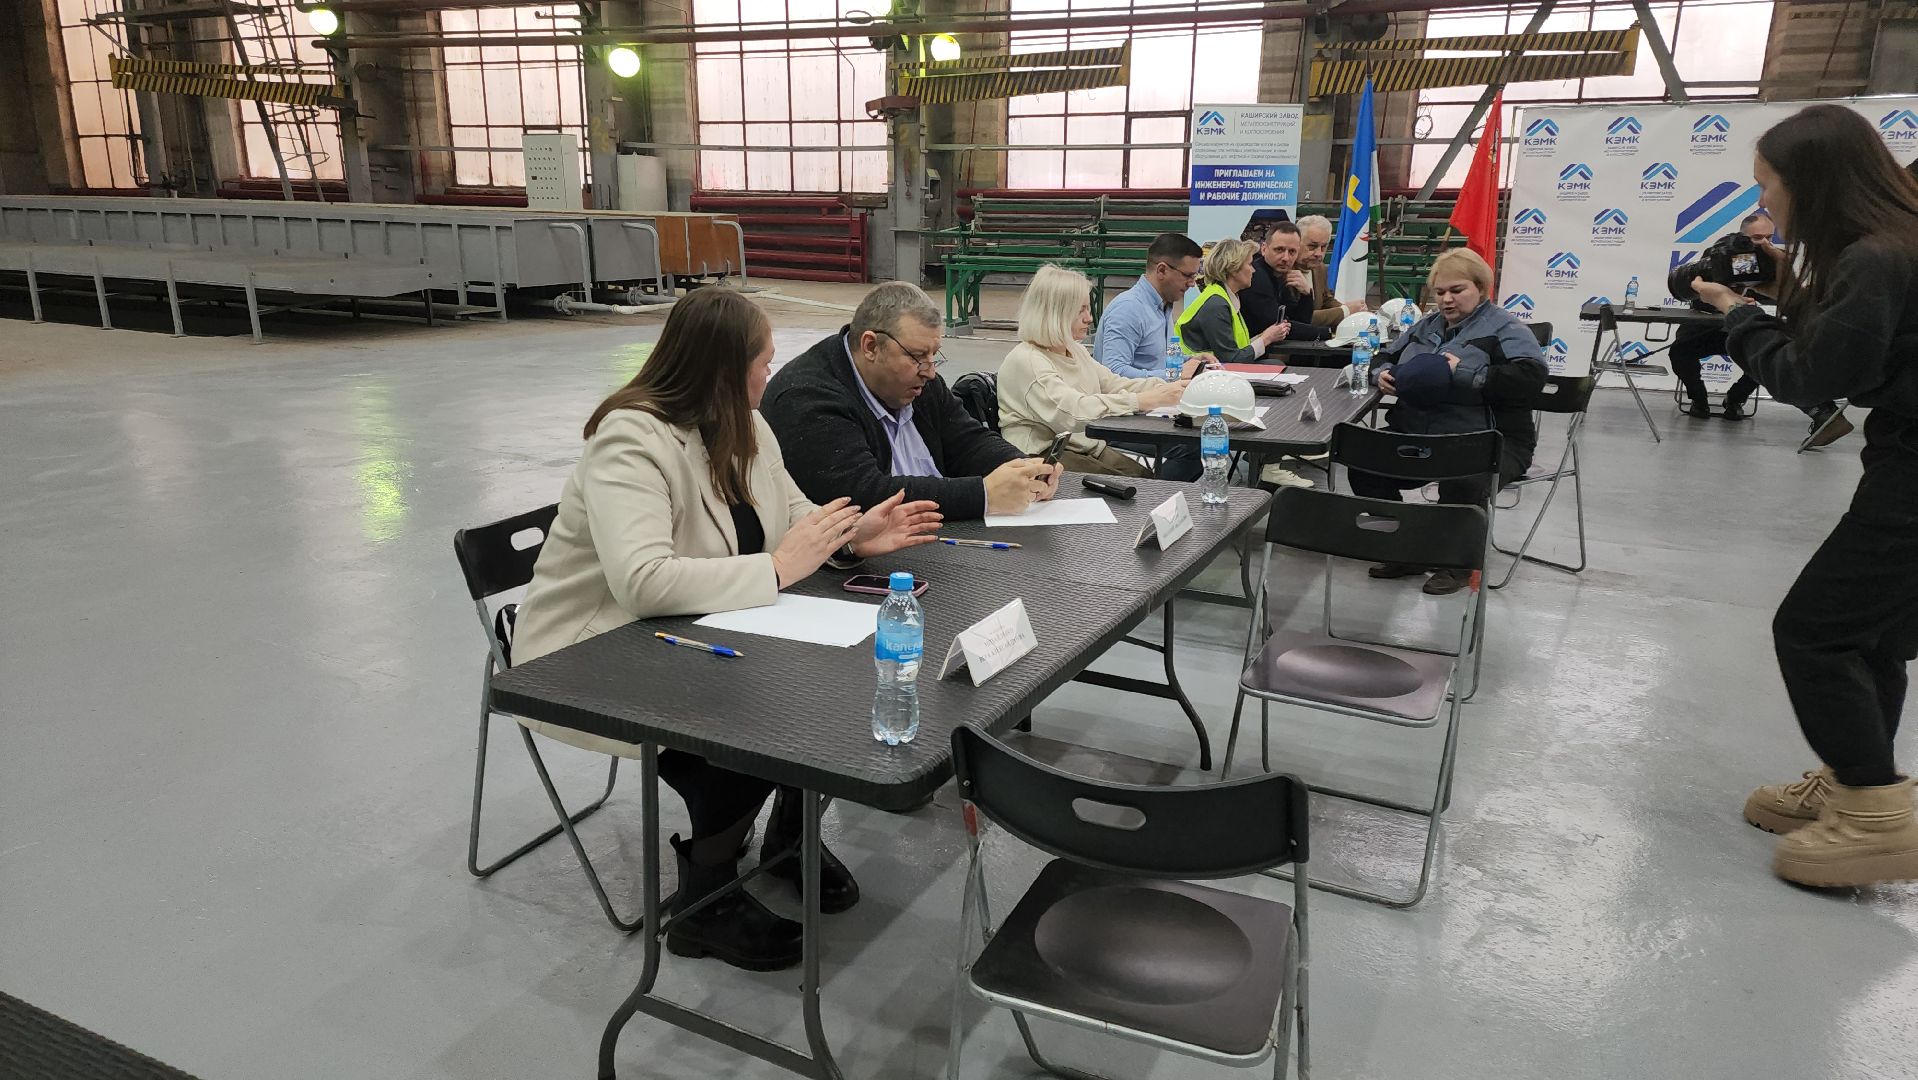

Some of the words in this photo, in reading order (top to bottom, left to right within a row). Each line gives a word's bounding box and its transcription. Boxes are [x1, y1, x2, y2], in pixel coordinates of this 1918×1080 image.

[1524, 138, 1558, 146] КЗМК
[1605, 136, 1640, 144] КЗМК
[1690, 134, 1727, 143] КЗМК
[1214, 169, 1264, 178] ПРИГЛАШАЕМ
[1265, 169, 1276, 178] НА
[1195, 181, 1293, 189] ИНЖЕНЕРНО-ТЕХНИЧЕСКИЕ
[1557, 182, 1591, 190] КЗМК
[1640, 181, 1676, 190] КЗМК
[1206, 192, 1240, 201] РАБОЧИЕ
[1241, 192, 1287, 202] ДОЛЖНОСТИ
[1512, 226, 1545, 235] КЗМК
[1592, 226, 1626, 235] КЗМК
[1545, 269, 1579, 278] КЗМК
